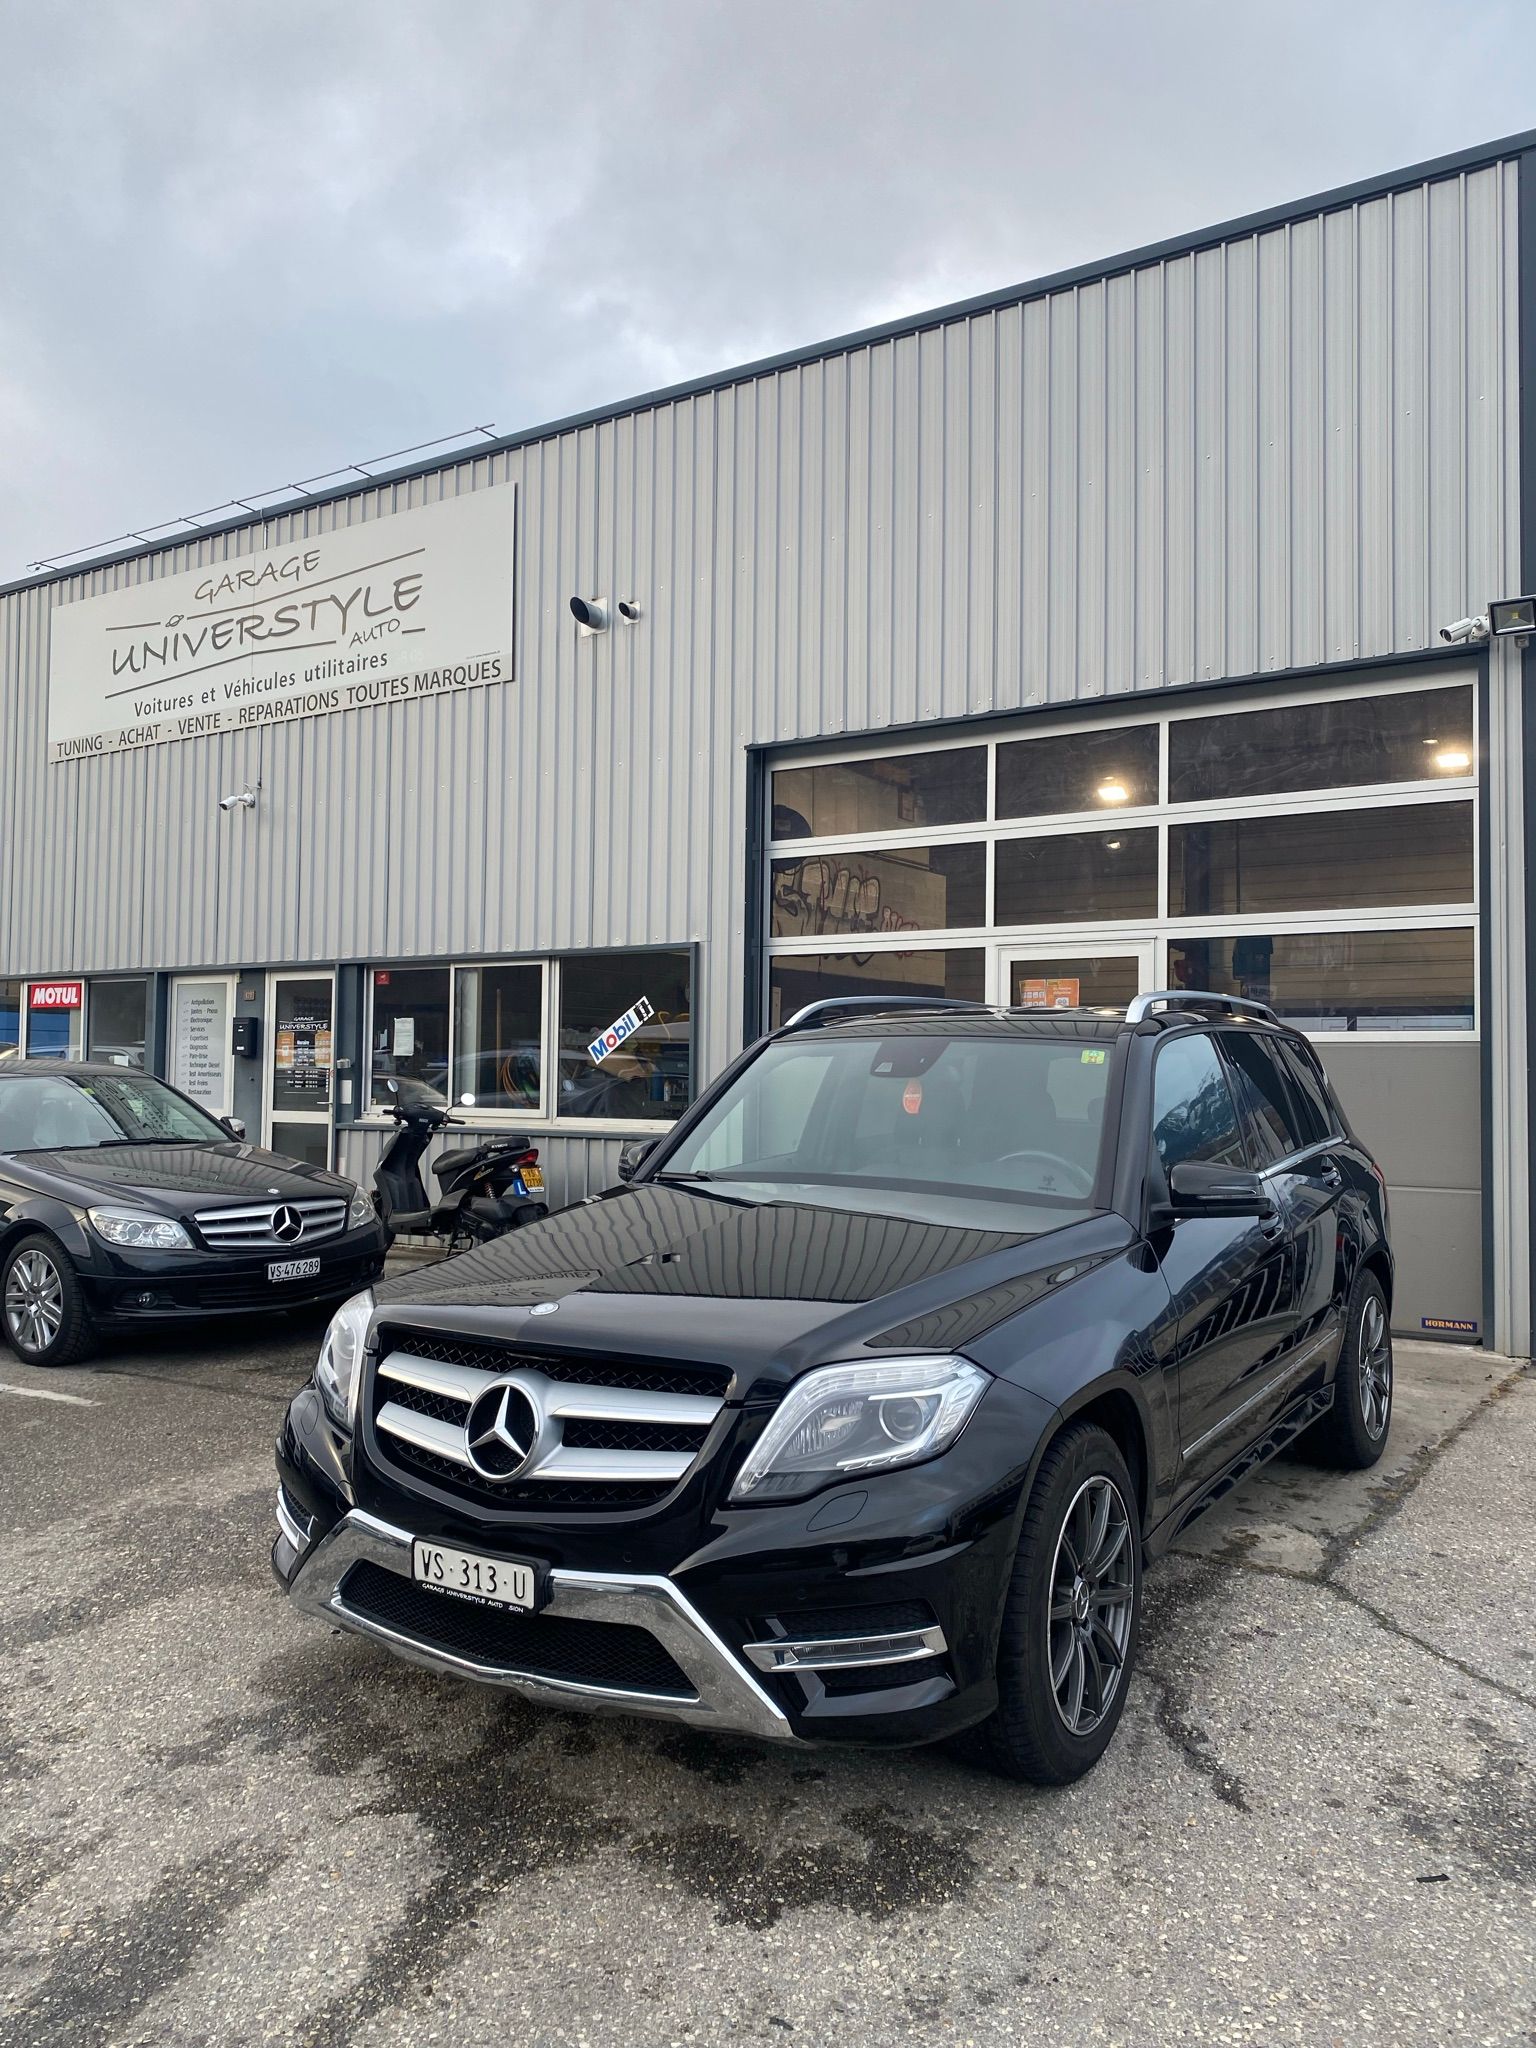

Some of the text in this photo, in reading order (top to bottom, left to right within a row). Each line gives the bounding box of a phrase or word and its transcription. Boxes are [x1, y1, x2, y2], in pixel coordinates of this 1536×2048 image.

[195, 550, 320, 603] GARAGE
[113, 574, 423, 675] UNIVERSTYLE
[349, 619, 400, 648] AUTO
[135, 694, 193, 717] Voitures
[201, 688, 216, 703] et
[224, 672, 296, 699] Véhicules
[304, 653, 388, 682] utilitaires
[57, 735, 103, 757] TUNING
[118, 724, 161, 746] ACHAT
[178, 713, 221, 735] VENTE
[239, 690, 339, 724] REPARATIONS
[346, 677, 409, 704] TOUTES
[414, 659, 501, 692] MARQUES
[33, 987, 78, 1004] MOTUL
[279, 1022, 328, 1031] UNIVERSTYLE
[591, 1014, 635, 1060] Mobil
[517, 1181, 527, 1195] L
[422, 1583, 524, 1614] GARAGE UNIVERSTYLE AUTO SION
